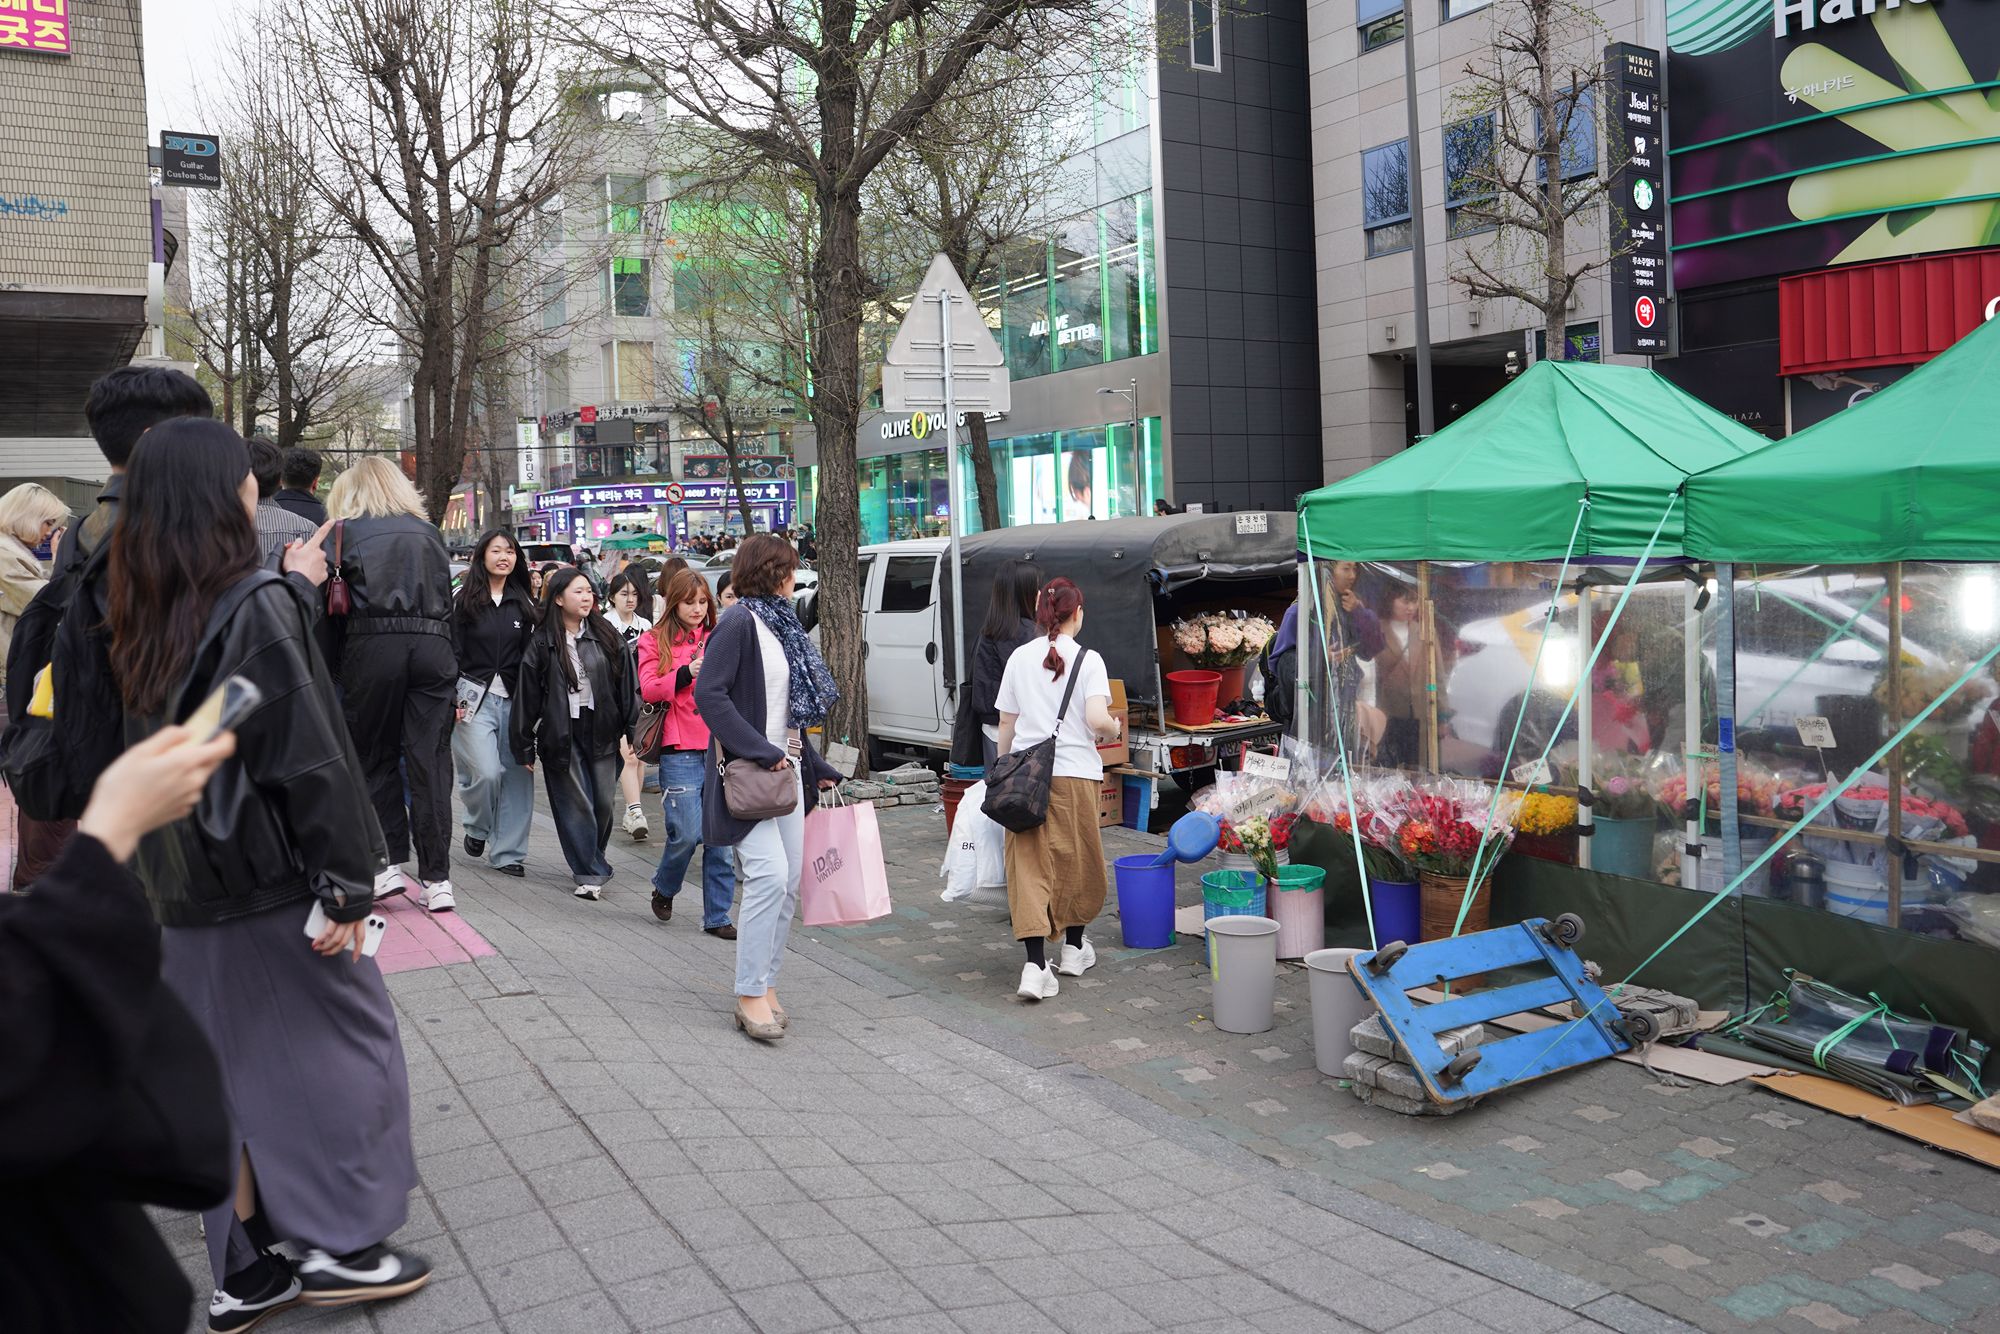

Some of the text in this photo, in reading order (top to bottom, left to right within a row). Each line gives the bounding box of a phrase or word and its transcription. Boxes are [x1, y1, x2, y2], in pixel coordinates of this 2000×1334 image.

[0, 15, 67, 49] 굿즈
[1628, 54, 1654, 68] MIRAE
[1628, 65, 1654, 78] PLAZA
[1803, 75, 1855, 97] 하나카드
[1629, 91, 1649, 111] Jfeel
[166, 135, 217, 157] MD
[180, 160, 204, 170] Guitar
[166, 169, 219, 183] Custom Shop
[1640, 303, 1651, 321] 약
[1057, 323, 1096, 346] BETTER
[598, 402, 650, 421] 麻辣工坊
[881, 411, 966, 440] OLIVE YOUG
[624, 488, 643, 499] 약국
[812, 856, 826, 876] ID
[816, 857, 843, 884] VINTAGE
